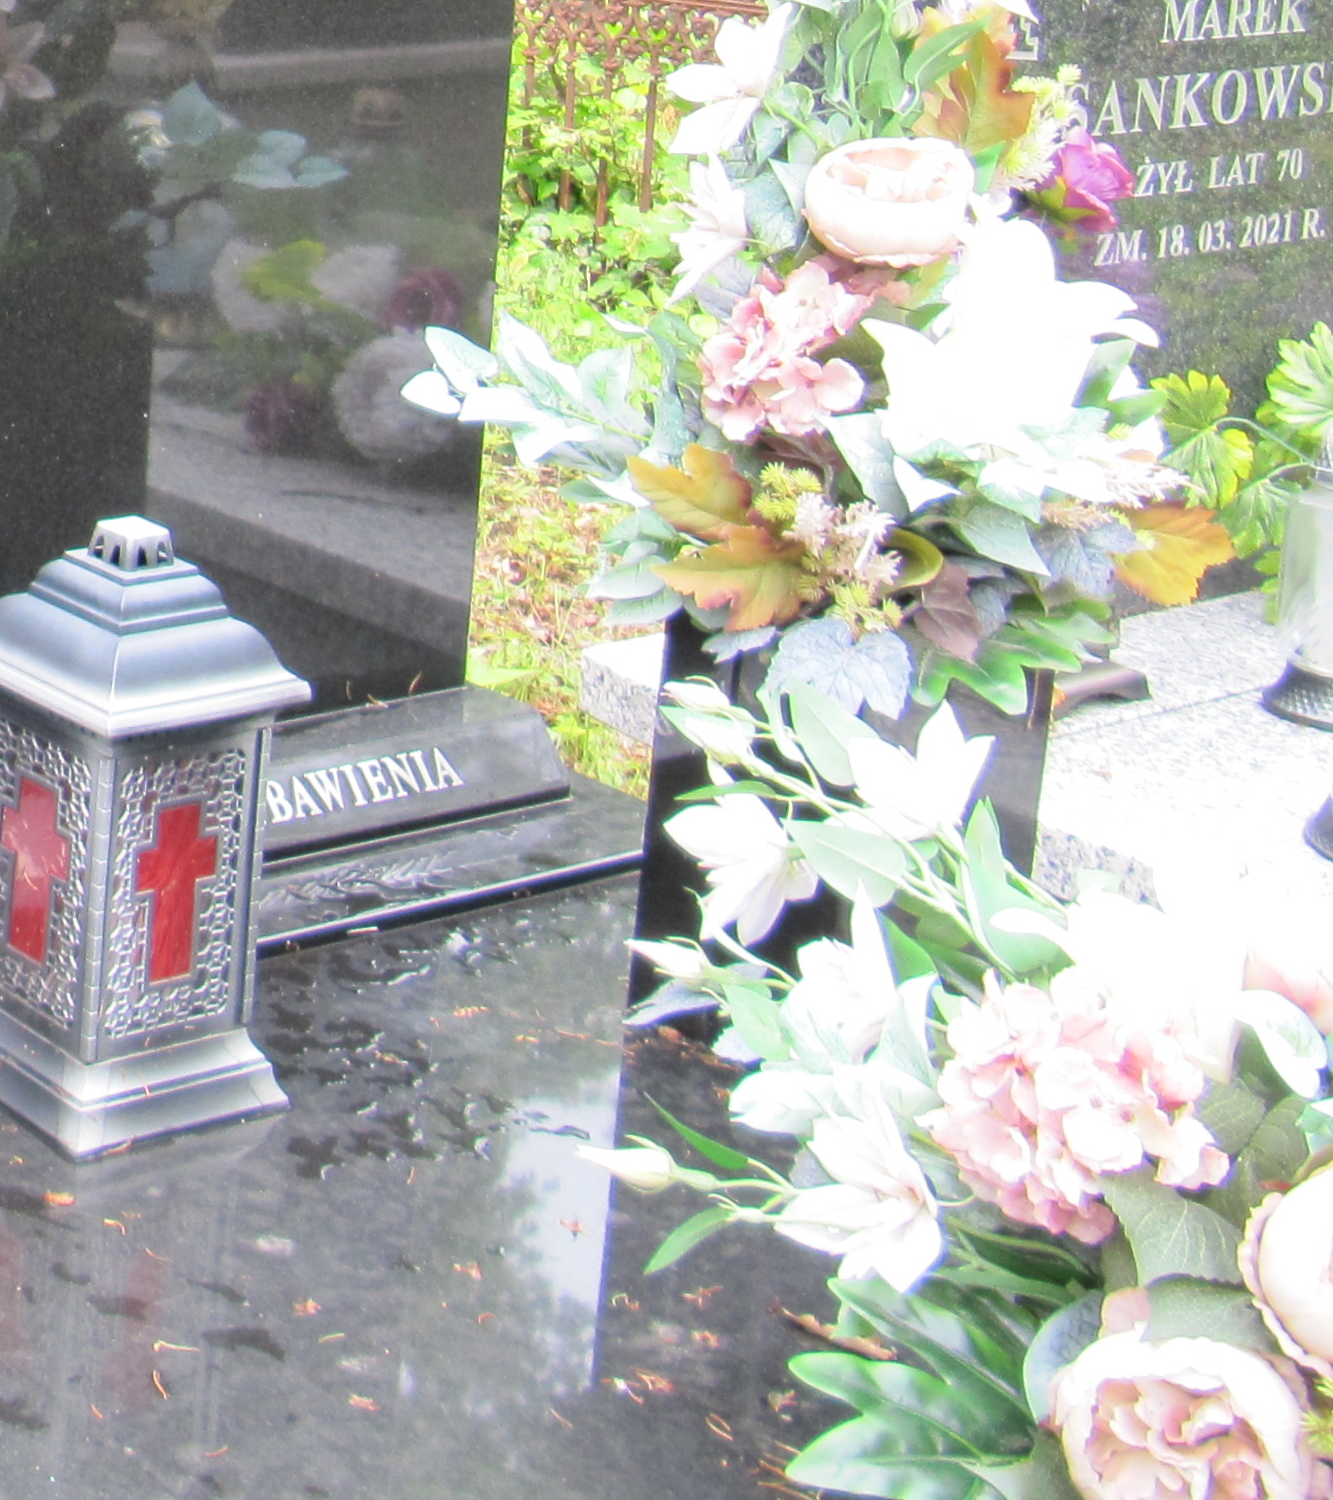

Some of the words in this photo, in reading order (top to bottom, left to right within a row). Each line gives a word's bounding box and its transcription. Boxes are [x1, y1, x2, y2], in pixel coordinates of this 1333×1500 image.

[1066, 60, 1333, 137] SANKOWS
[1134, 156, 1193, 197] ŻYŁ
[1207, 152, 1265, 189] LAT
[1276, 148, 1303, 182] 70
[1094, 229, 1147, 267] ZM.
[1157, 224, 1190, 258] 18.
[1198, 219, 1231, 253] 03.
[1239, 208, 1293, 248] 2021
[1300, 208, 1325, 240] R.
[265, 747, 464, 824] BAWIENIA
